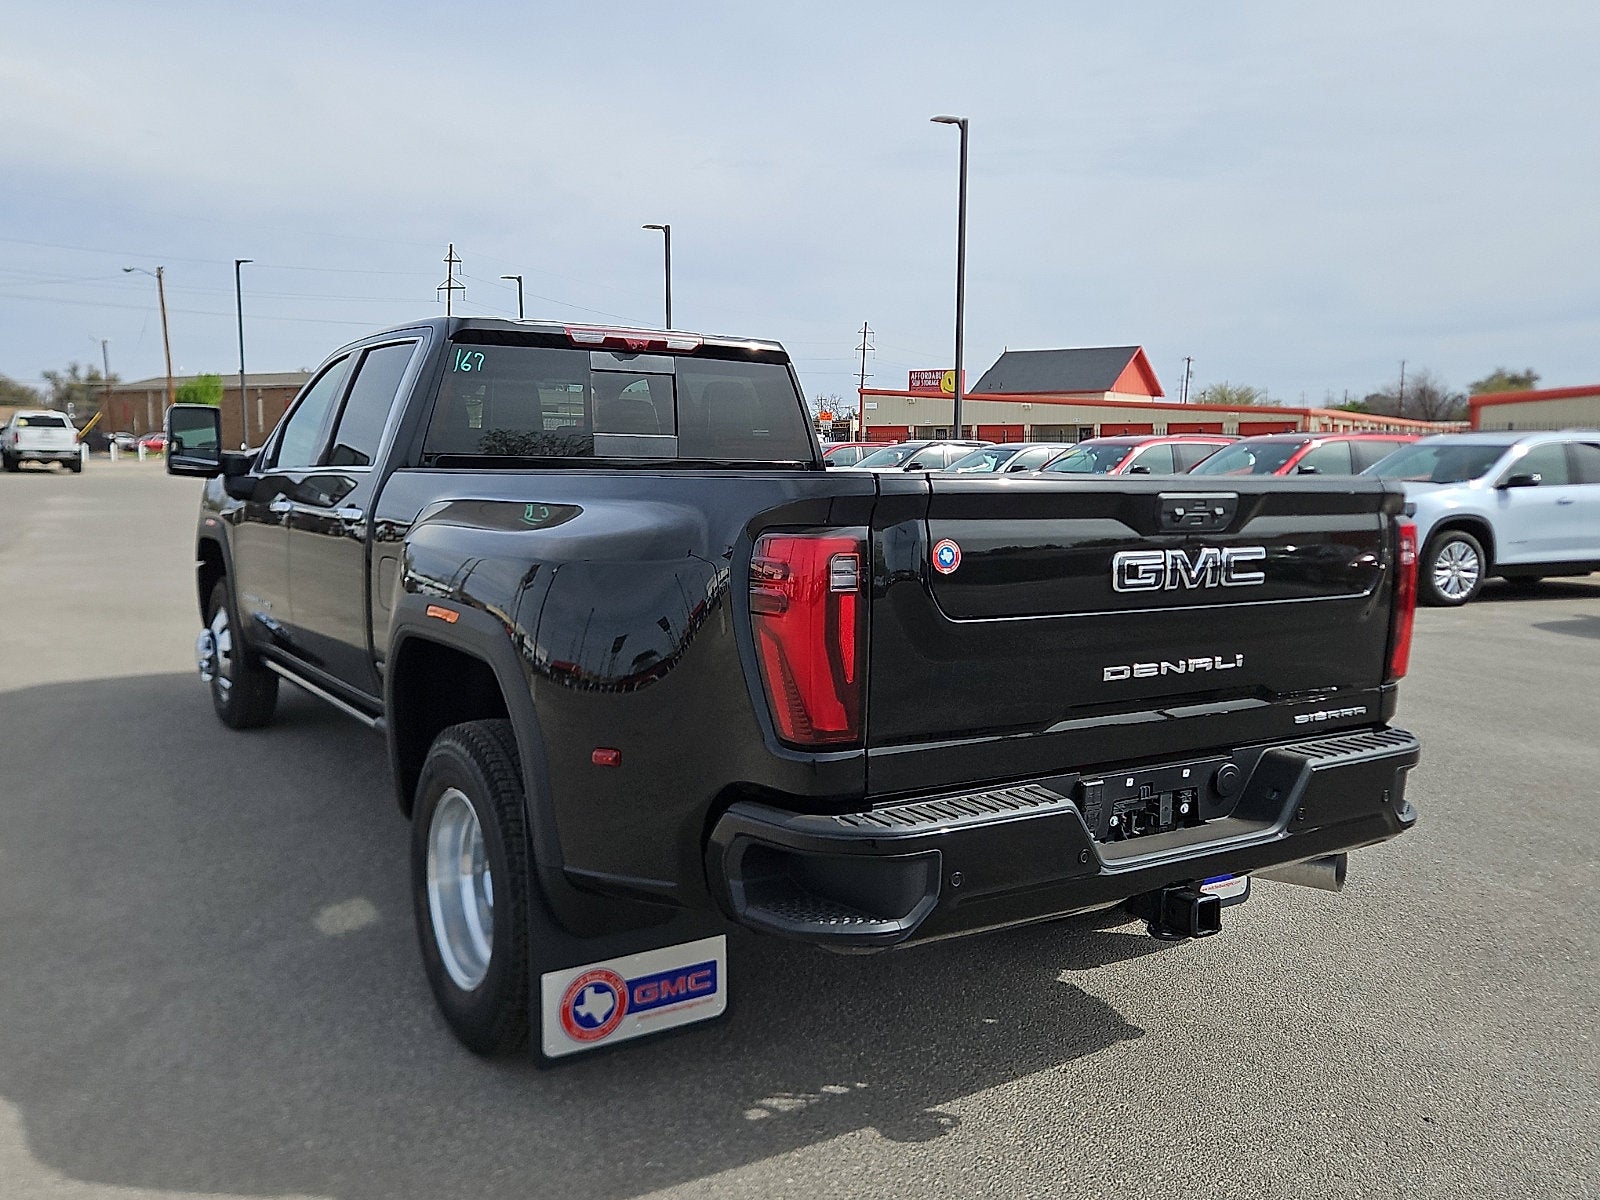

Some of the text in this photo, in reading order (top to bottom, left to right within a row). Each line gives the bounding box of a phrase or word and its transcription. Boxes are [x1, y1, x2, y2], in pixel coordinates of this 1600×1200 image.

[453, 348, 485, 372] 167
[1112, 546, 1267, 593] GMC
[1102, 653, 1244, 682] DENALI
[1293, 706, 1367, 724] SIERRA
[633, 968, 713, 1005] GMC
